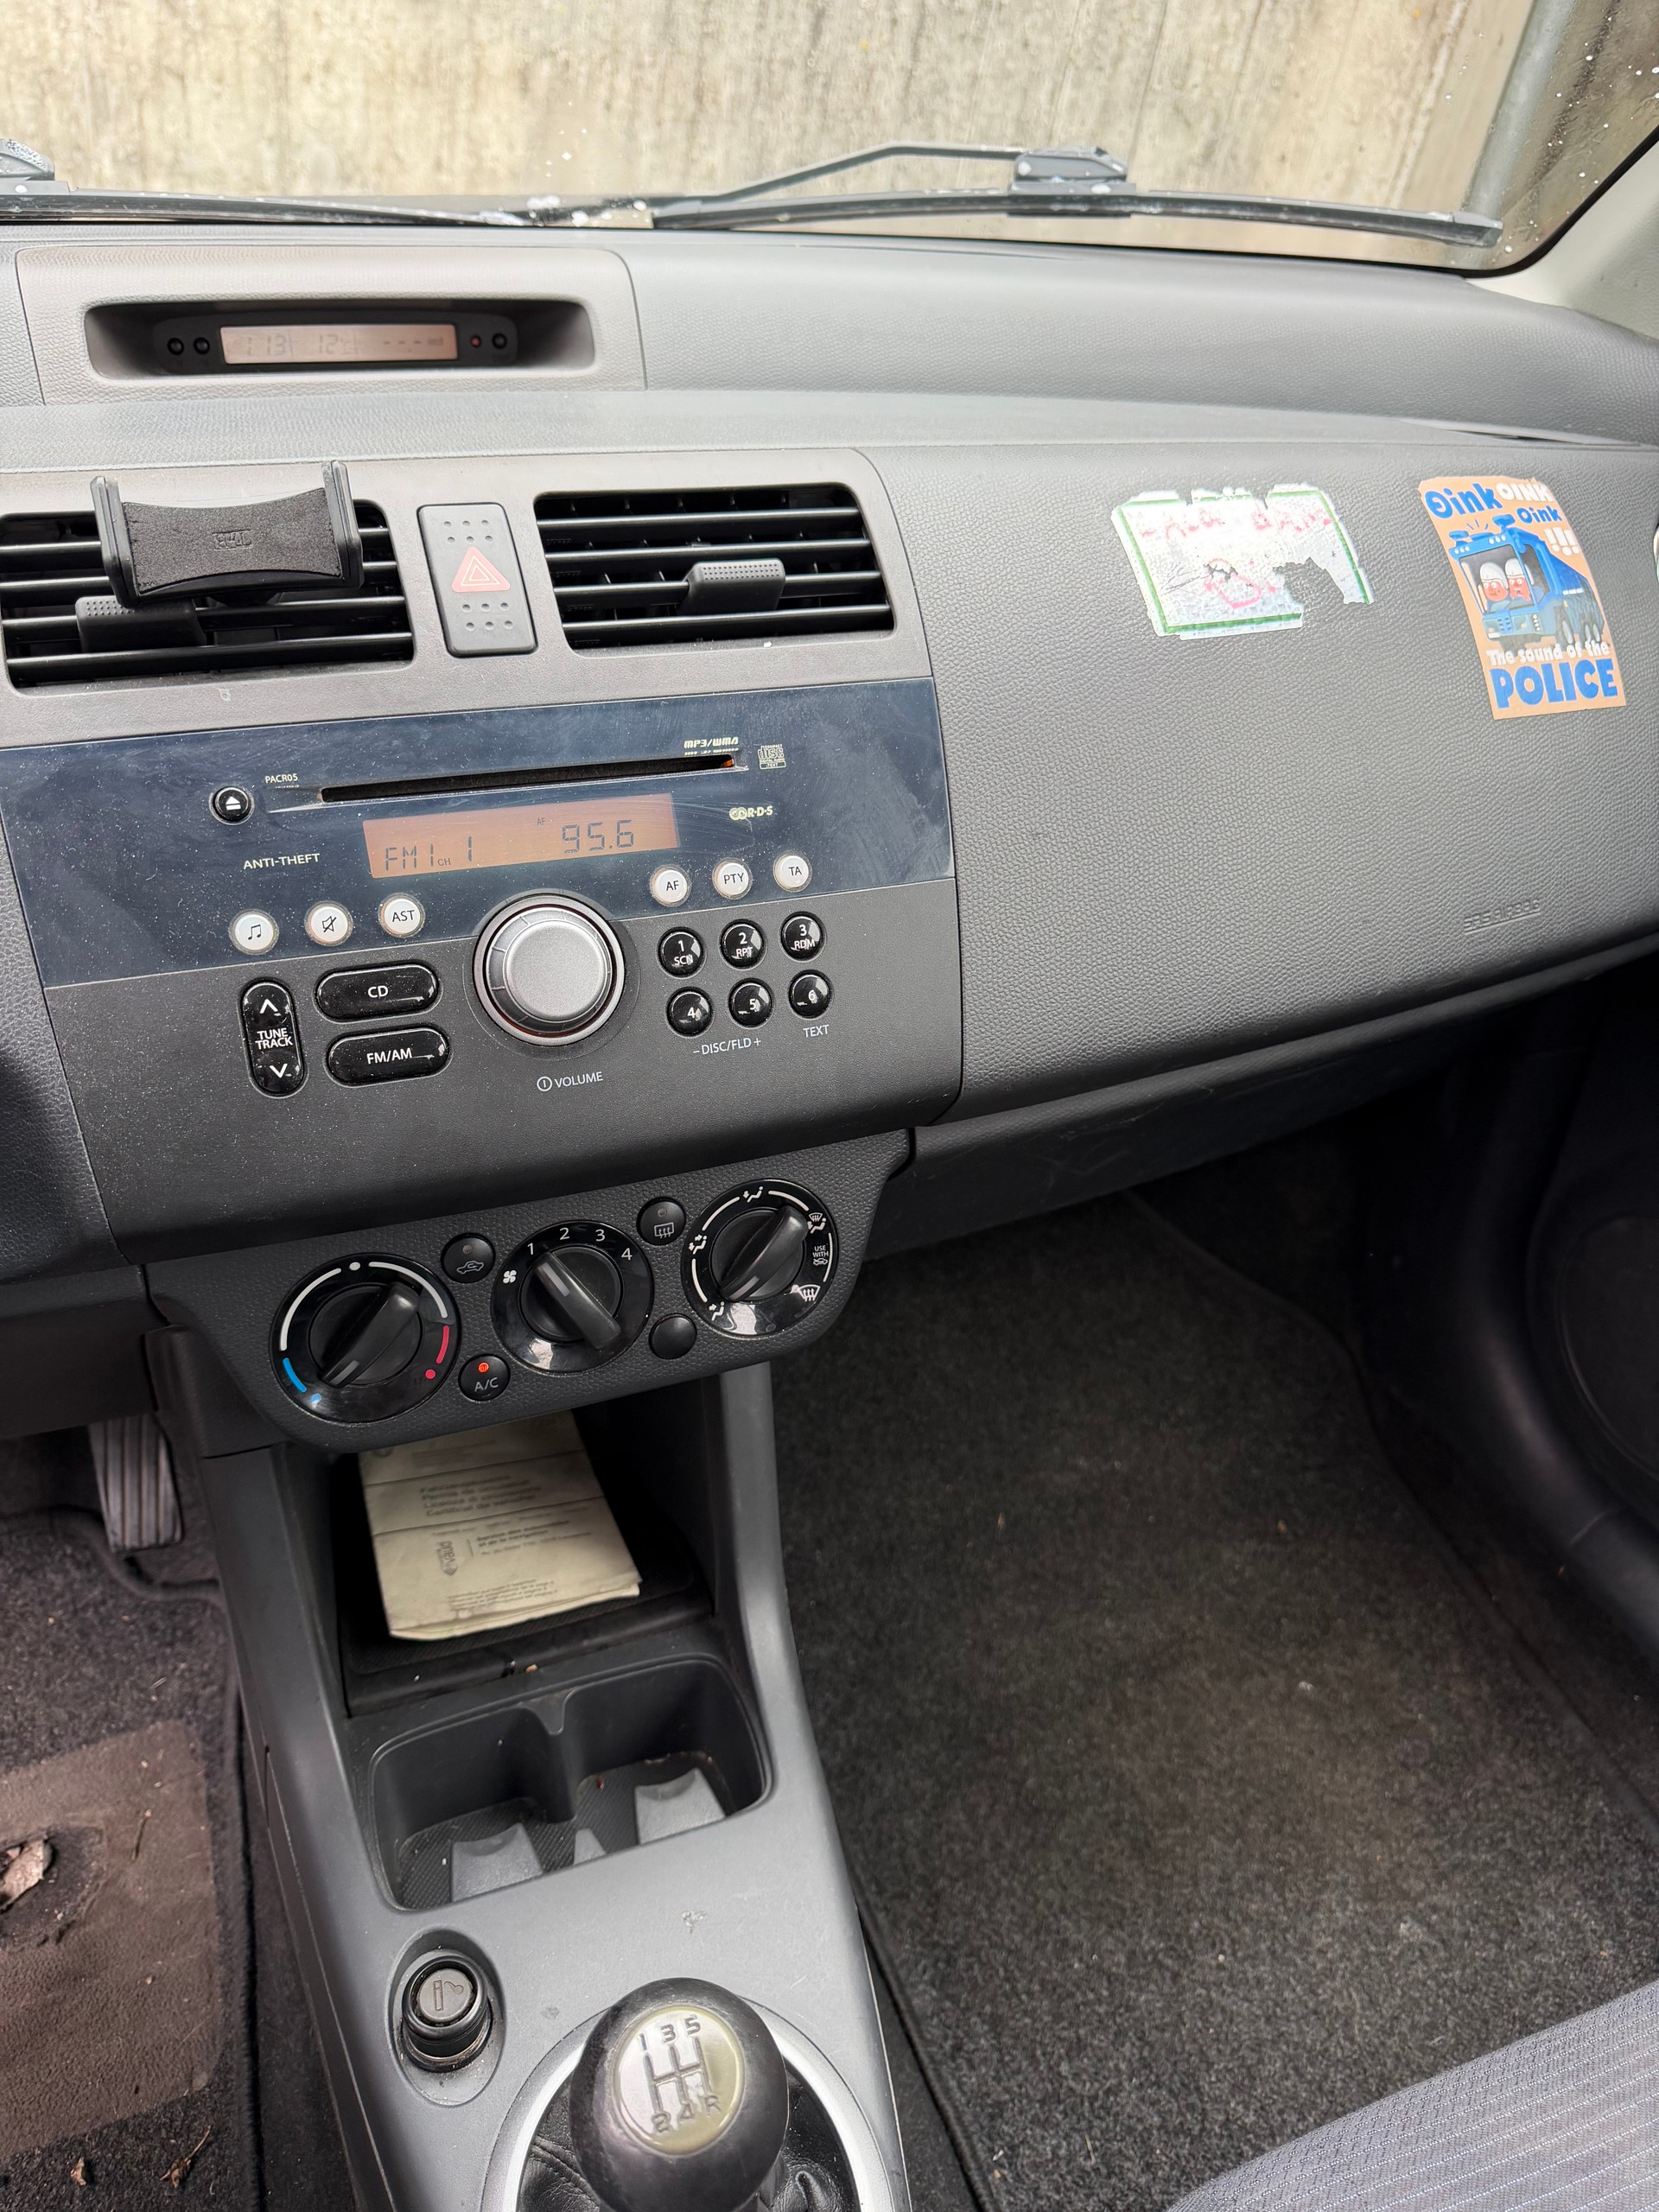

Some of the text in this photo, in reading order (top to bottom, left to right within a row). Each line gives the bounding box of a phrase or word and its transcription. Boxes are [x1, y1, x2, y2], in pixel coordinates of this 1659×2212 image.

[1425, 483, 1503, 518] Oink
[1516, 505, 1562, 524] Oink
[1486, 640, 1610, 665] The sound of the
[1490, 658, 1618, 709] POLICE
[683, 736, 739, 749] MP3/WMA
[562, 820, 634, 855] 95.6
[243, 853, 321, 870] ANTI-THEFT
[438, 858, 451, 868] CH
[788, 866, 803, 877] TA
[723, 872, 744, 885] PTY
[665, 880, 680, 892] AF
[391, 909, 416, 923] AST
[798, 925, 807, 937] 3
[739, 932, 748, 944] 2
[794, 938, 816, 950] RDM
[677, 940, 684, 953] 1
[735, 947, 753, 958] RPT
[674, 955, 694, 967] SCN
[367, 985, 389, 999] CD
[808, 989, 817, 1002] 6
[749, 998, 757, 1011] 5
[687, 1007, 696, 1019] 4
[257, 1027, 289, 1040] TUNE
[803, 1025, 830, 1038] TEXT
[255, 1036, 294, 1050] TRACK
[366, 1048, 412, 1065] FM/AM
[554, 1071, 604, 1089] VOLUME
[527, 1228, 632, 1261] 1 2 3 4
[474, 1377, 499, 1392] A/C
[639, 2014, 702, 2051] 1 3 5
[652, 2111, 672, 2133] 2
[703, 2094, 721, 2117] R
